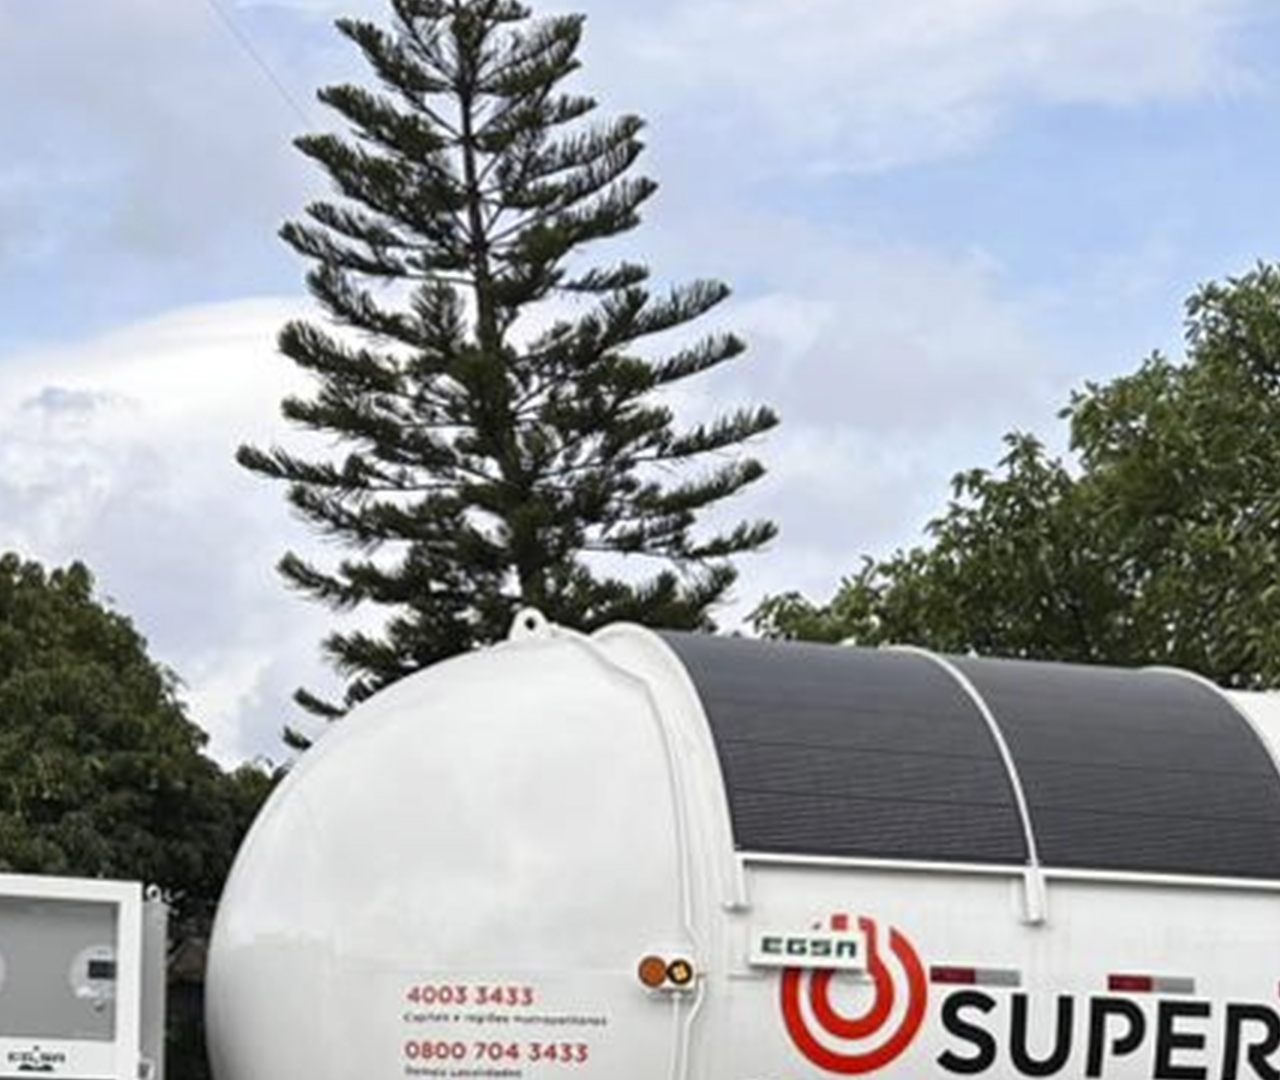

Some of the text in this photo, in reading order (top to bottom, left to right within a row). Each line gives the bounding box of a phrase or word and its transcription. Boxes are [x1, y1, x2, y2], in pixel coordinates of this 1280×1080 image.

[406, 985, 534, 1006] 4003 3433
[405, 1040, 589, 1062] 0800 704 3433
